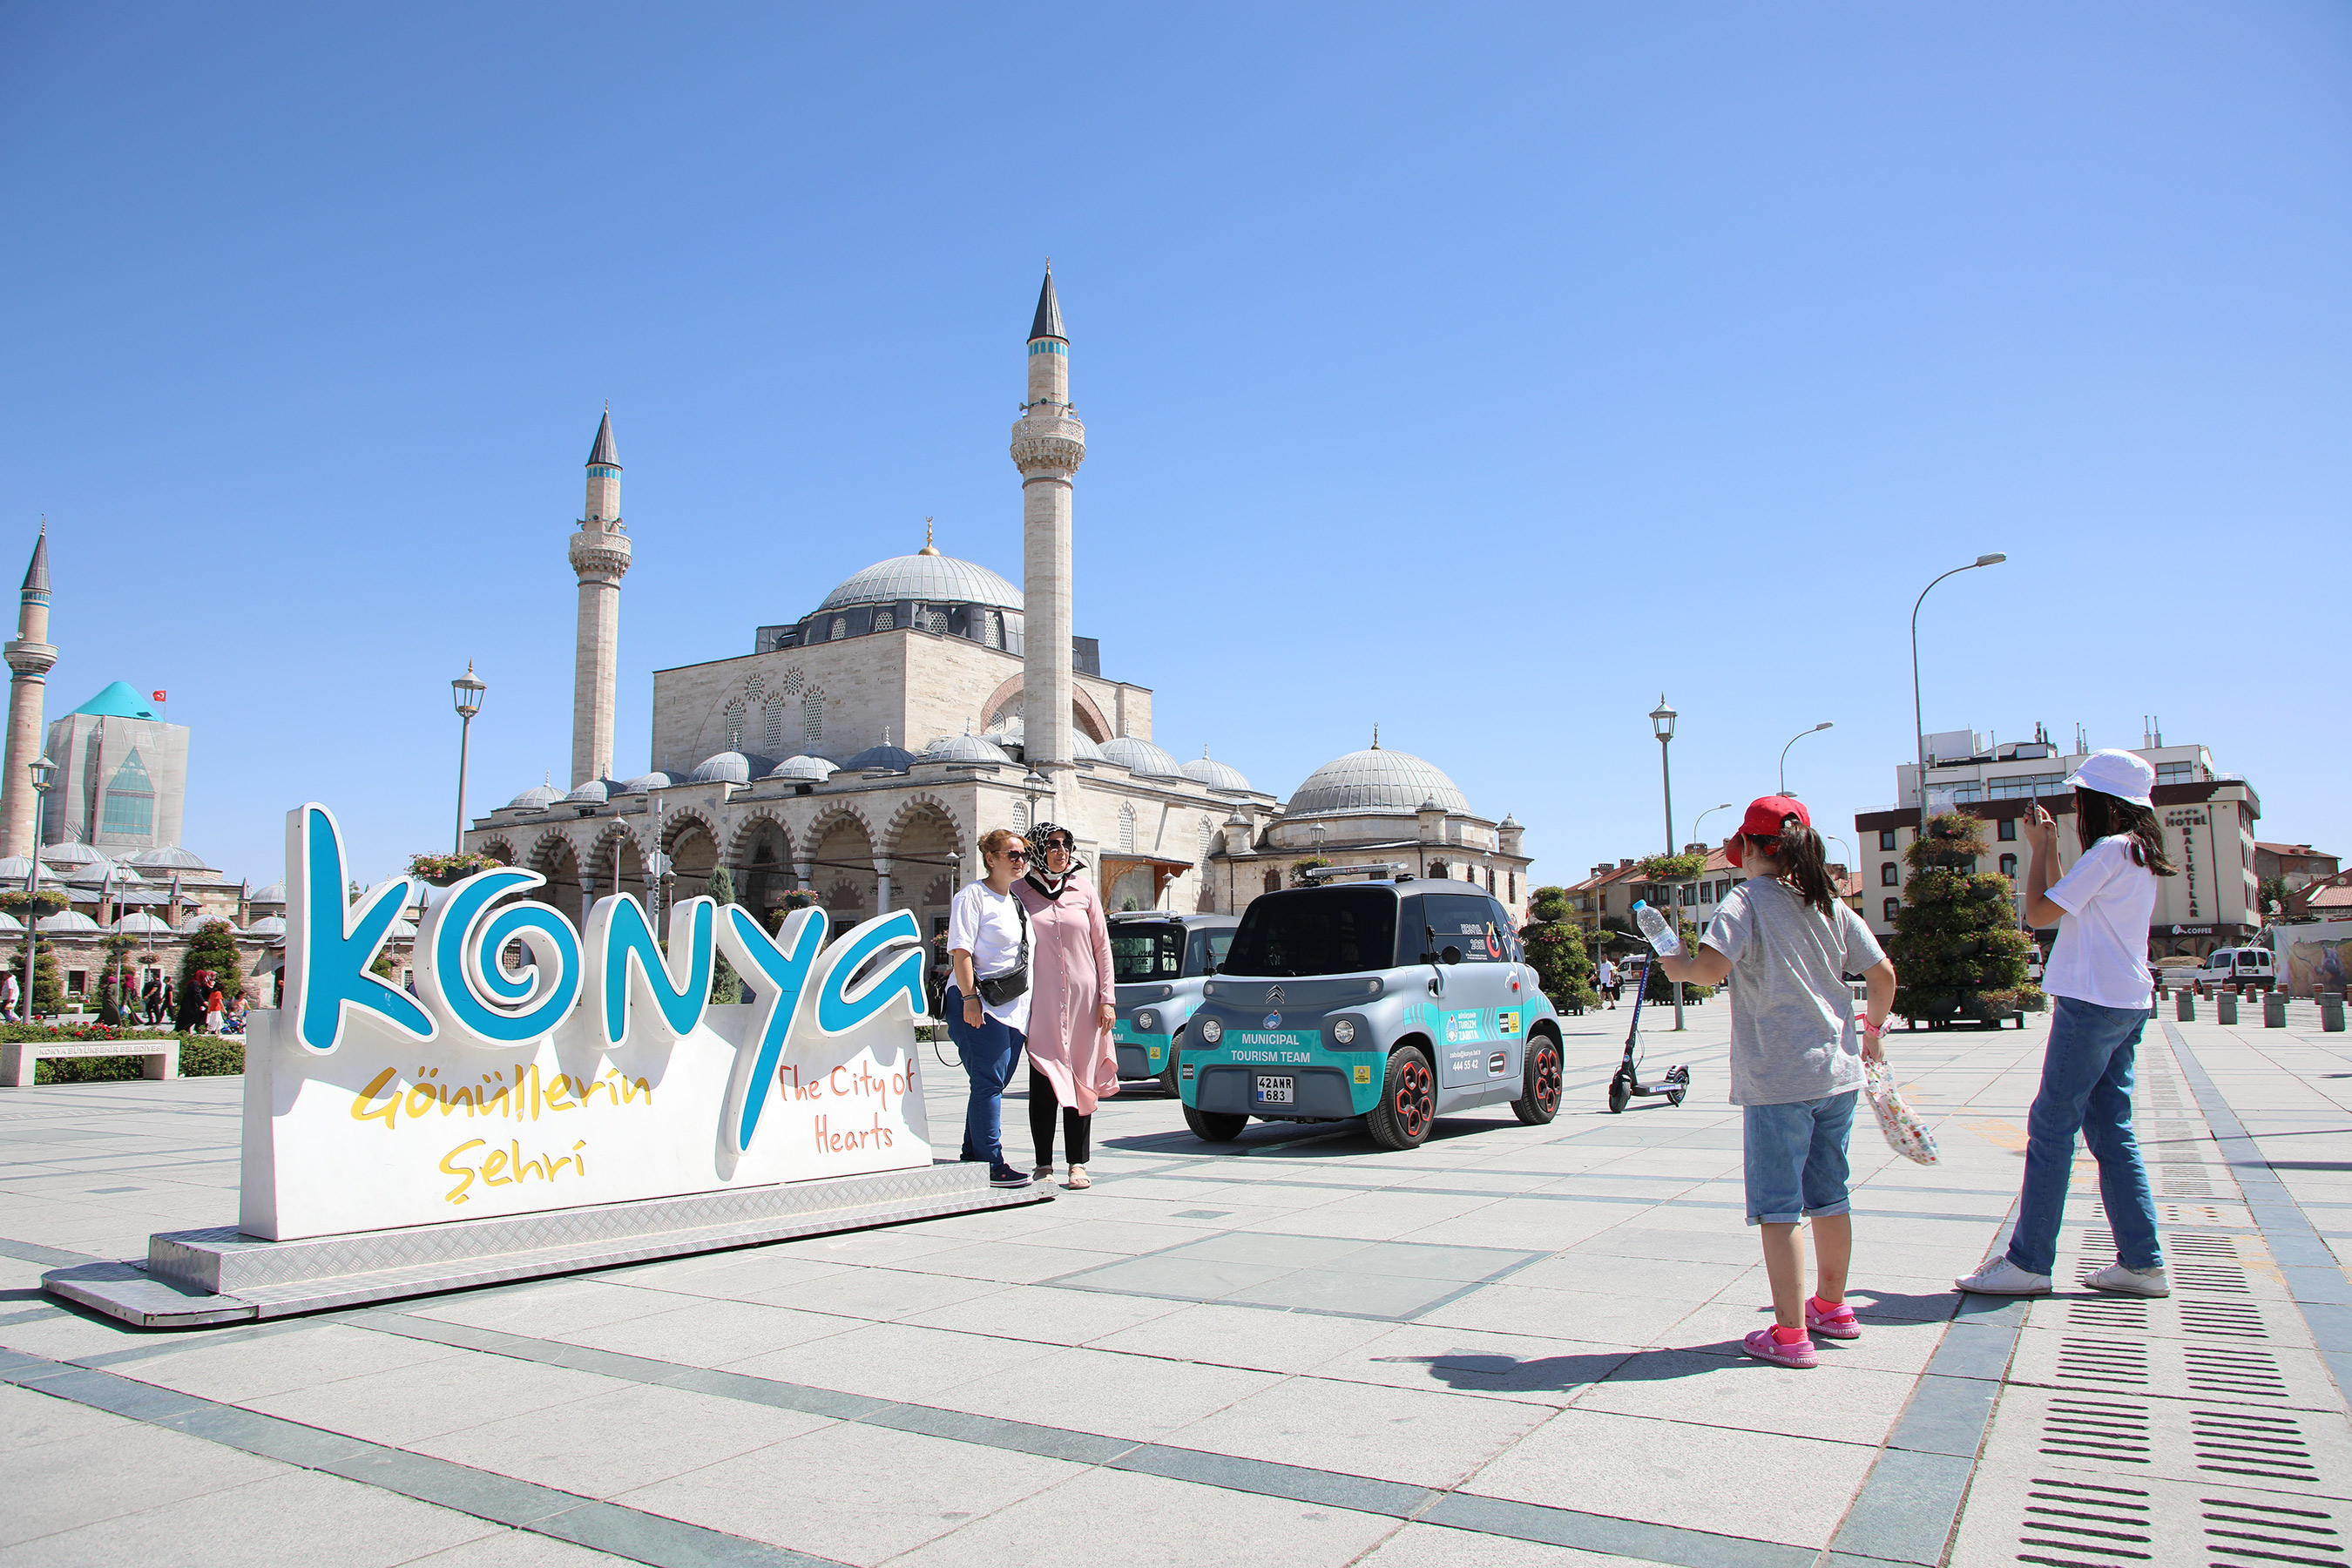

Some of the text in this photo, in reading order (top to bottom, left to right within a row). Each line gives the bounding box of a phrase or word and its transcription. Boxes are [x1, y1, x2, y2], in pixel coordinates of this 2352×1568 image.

[2165, 815, 2207, 827] HOTEL
[1241, 1033, 1300, 1045] MUNICIPAL
[38, 1047, 66, 1056] KONYA
[1231, 1050, 1311, 1063] TOURISM TEAM
[1452, 1058, 1478, 1071] 444 55 42
[780, 1058, 915, 1112] The City of
[1259, 1078, 1291, 1089] 42ANR
[350, 1064, 652, 1130] Gönüllerin
[1266, 1090, 1285, 1101] 683
[814, 1112, 893, 1154] Hearts
[439, 1139, 586, 1205] Şehri
